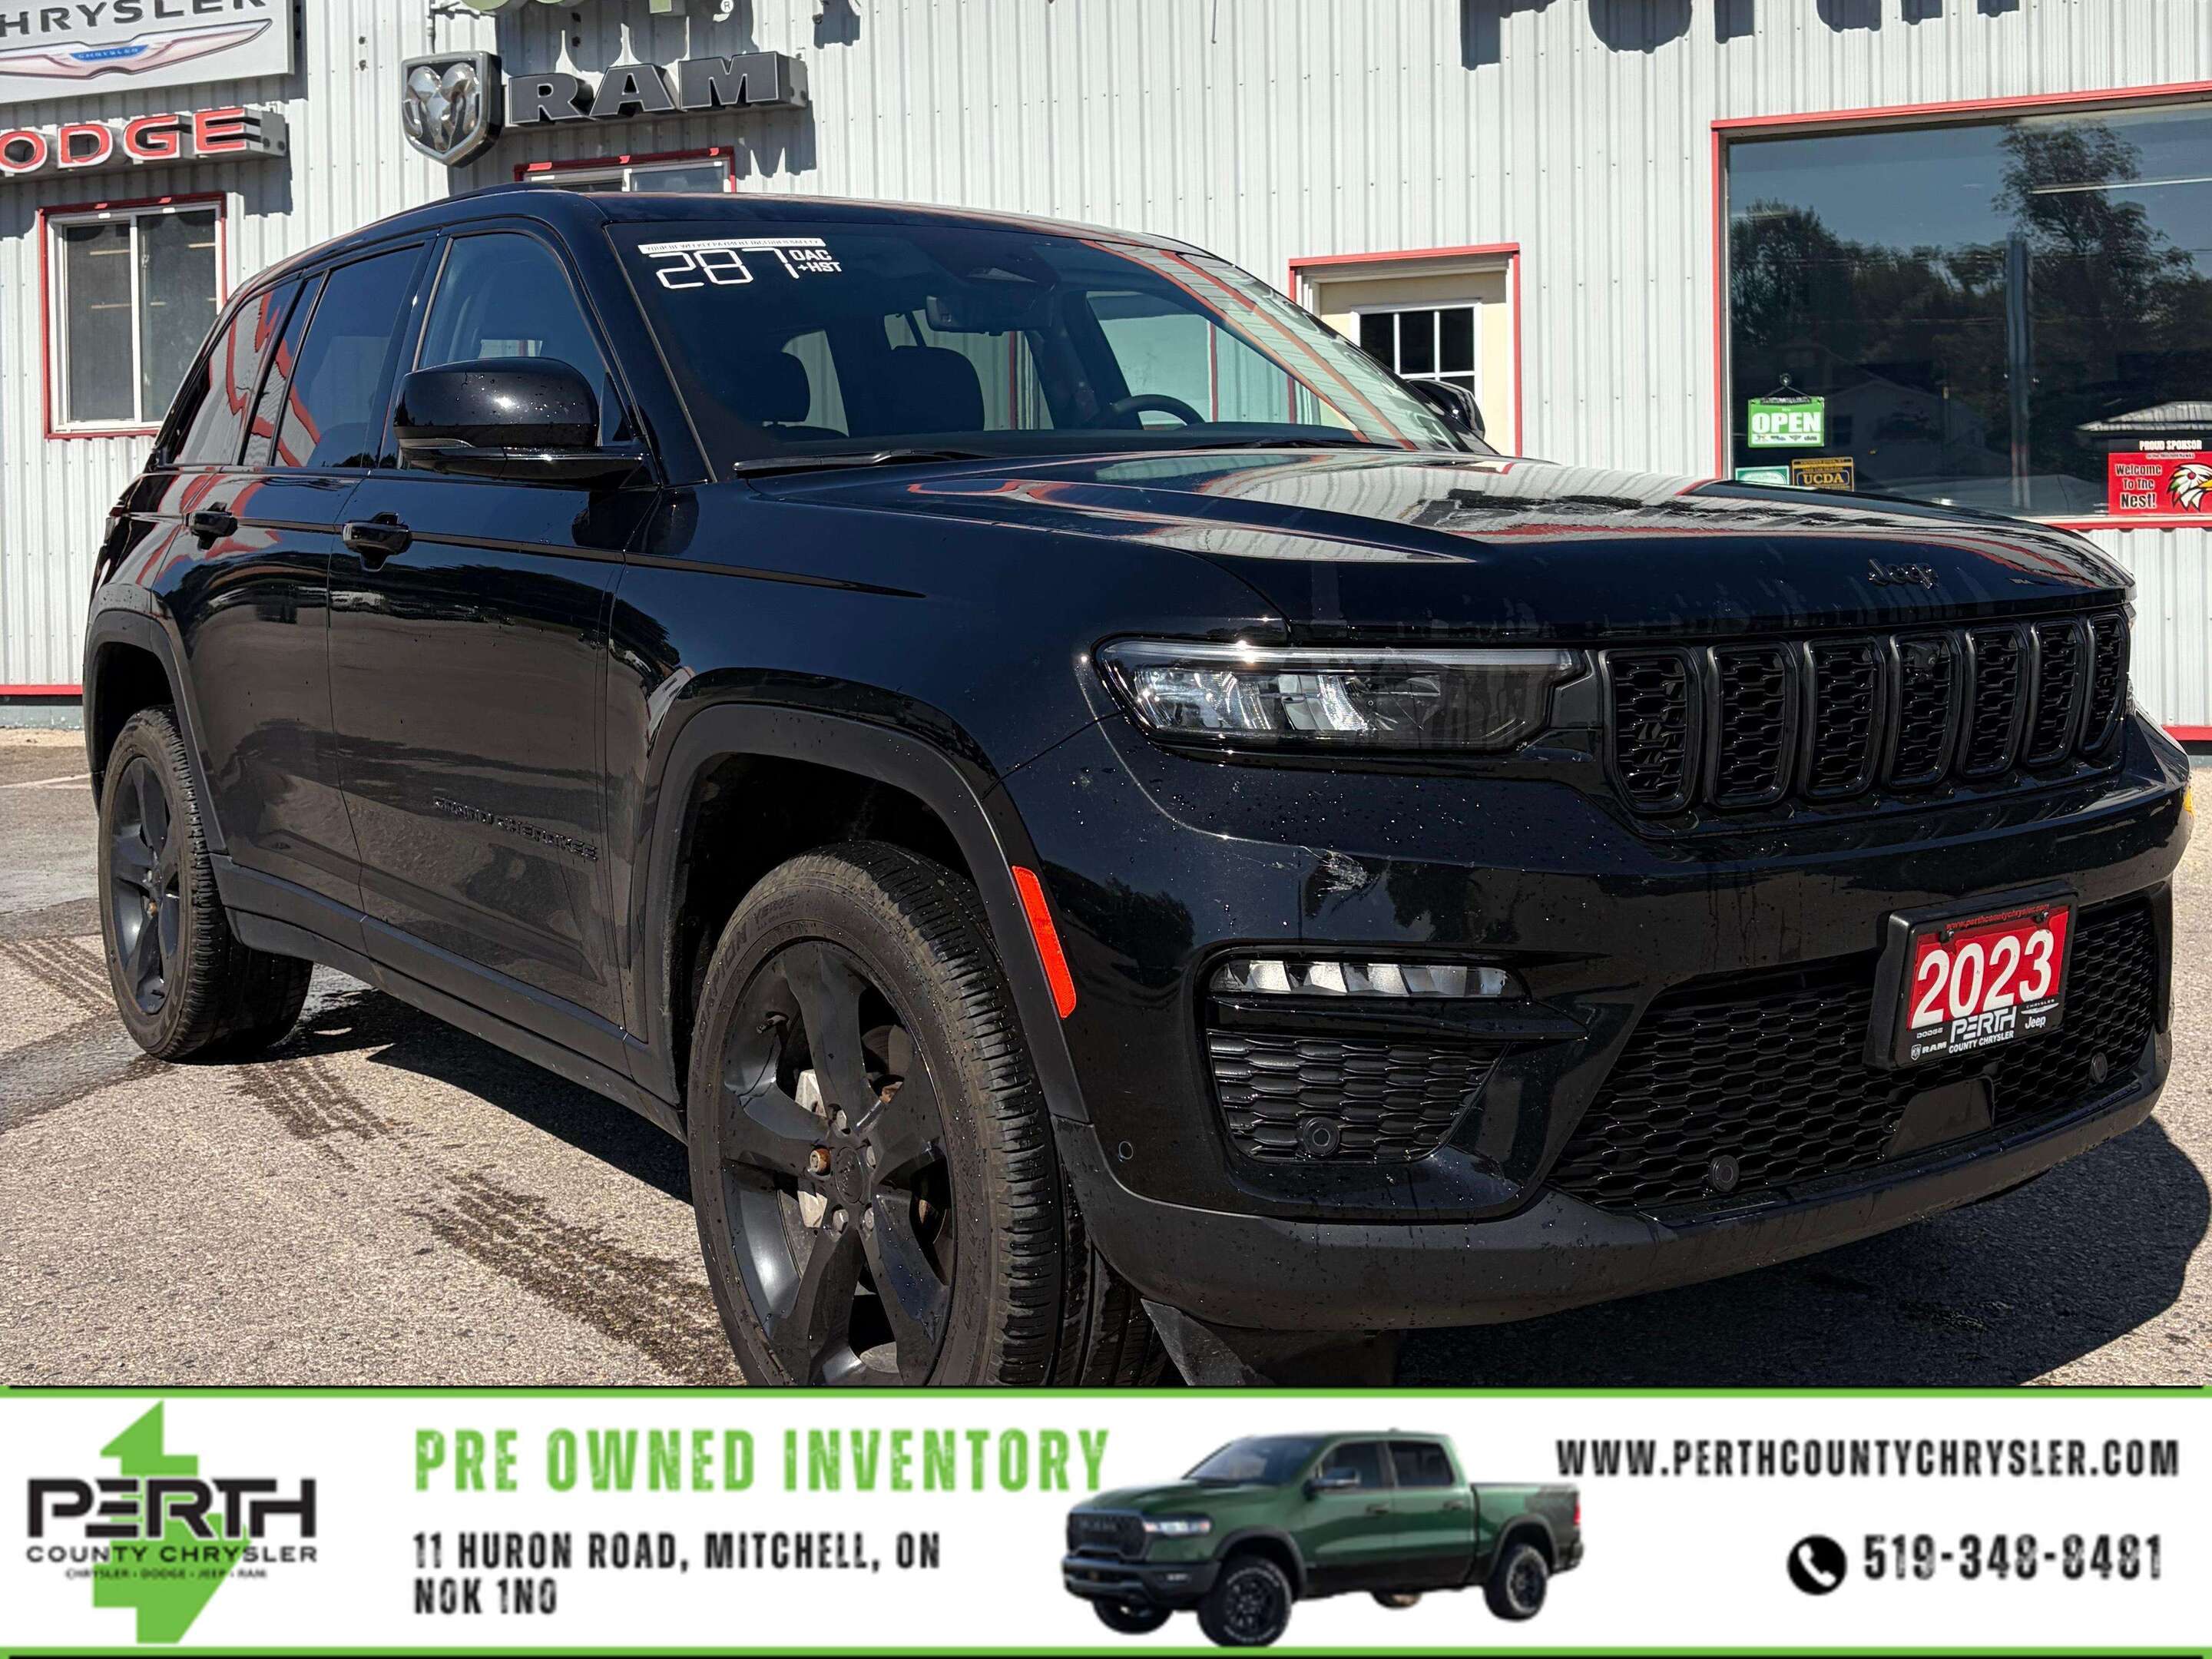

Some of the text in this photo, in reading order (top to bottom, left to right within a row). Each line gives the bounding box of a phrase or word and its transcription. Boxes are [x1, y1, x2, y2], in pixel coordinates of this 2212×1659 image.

[0, 0, 266, 37] HRYSLE
[508, 51, 780, 125] RAM
[0, 107, 247, 174] ODGE
[789, 250, 833, 261] OAC
[649, 247, 800, 289] 287
[798, 262, 843, 272] +HST
[1752, 412, 1822, 433] OPEN
[2139, 439, 2203, 451] PROUD SPONSOR
[2116, 465, 2161, 476] Welcome
[1803, 473, 1844, 485] UCDA
[2123, 478, 2154, 489] To The
[2121, 492, 2157, 508] Nest!
[1911, 929, 2055, 1029] 2023
[2026, 998, 2055, 1008] CHRYSLER
[1951, 1006, 2017, 1043] PERTH
[2025, 1015, 2046, 1030] Jeep
[1916, 1027, 1943, 1039] DODGE
[1922, 1041, 1947, 1054] RAM
[1949, 1030, 2014, 1054] COUNTY CHRYSLER
